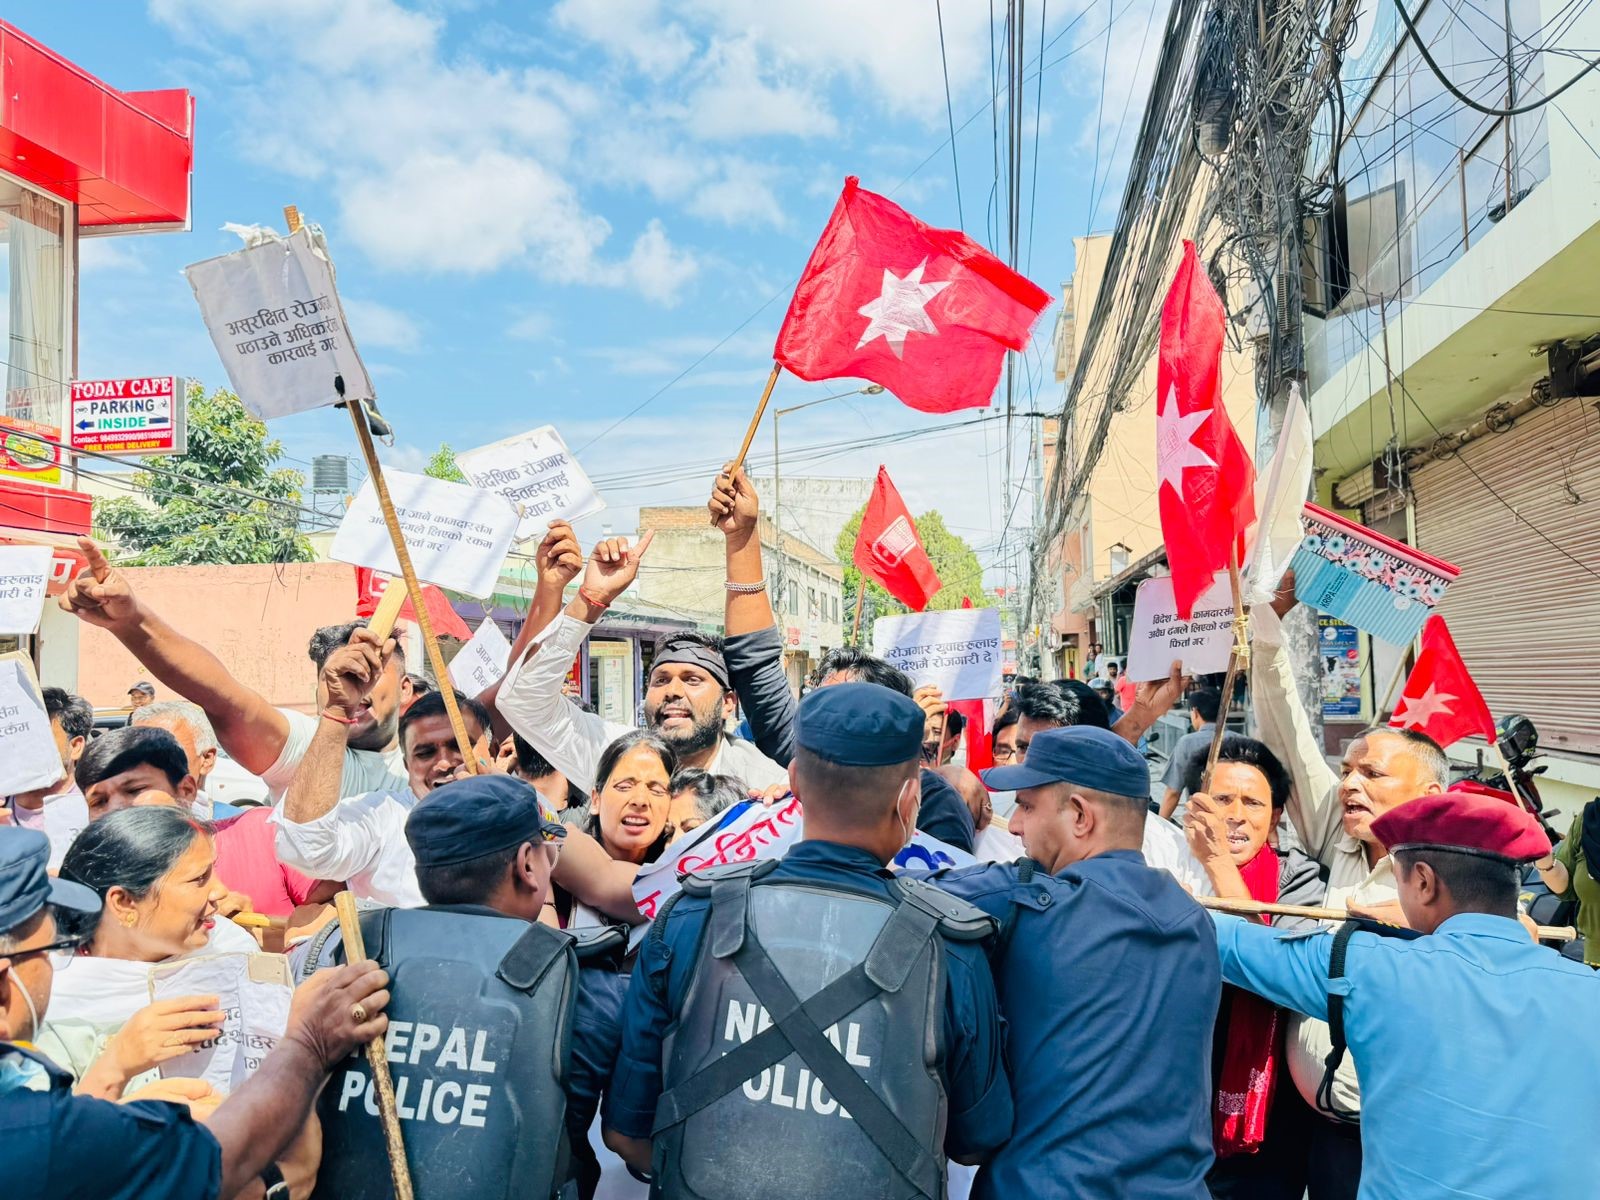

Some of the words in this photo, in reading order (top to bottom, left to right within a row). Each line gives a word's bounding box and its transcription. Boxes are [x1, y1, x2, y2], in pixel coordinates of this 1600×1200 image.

[225, 309, 289, 335] असुरक्षित
[236, 331, 281, 355] पठाउने
[266, 339, 317, 365] कारवाई
[73, 381, 127, 399] TODAY
[130, 377, 171, 395] CAFE
[90, 399, 155, 415] PARKING
[98, 417, 147, 429] INSIDE
[127, 440, 161, 449] DELIVERY
[521, 452, 569, 476] रोजगार
[351, 1020, 496, 1073] EPAL
